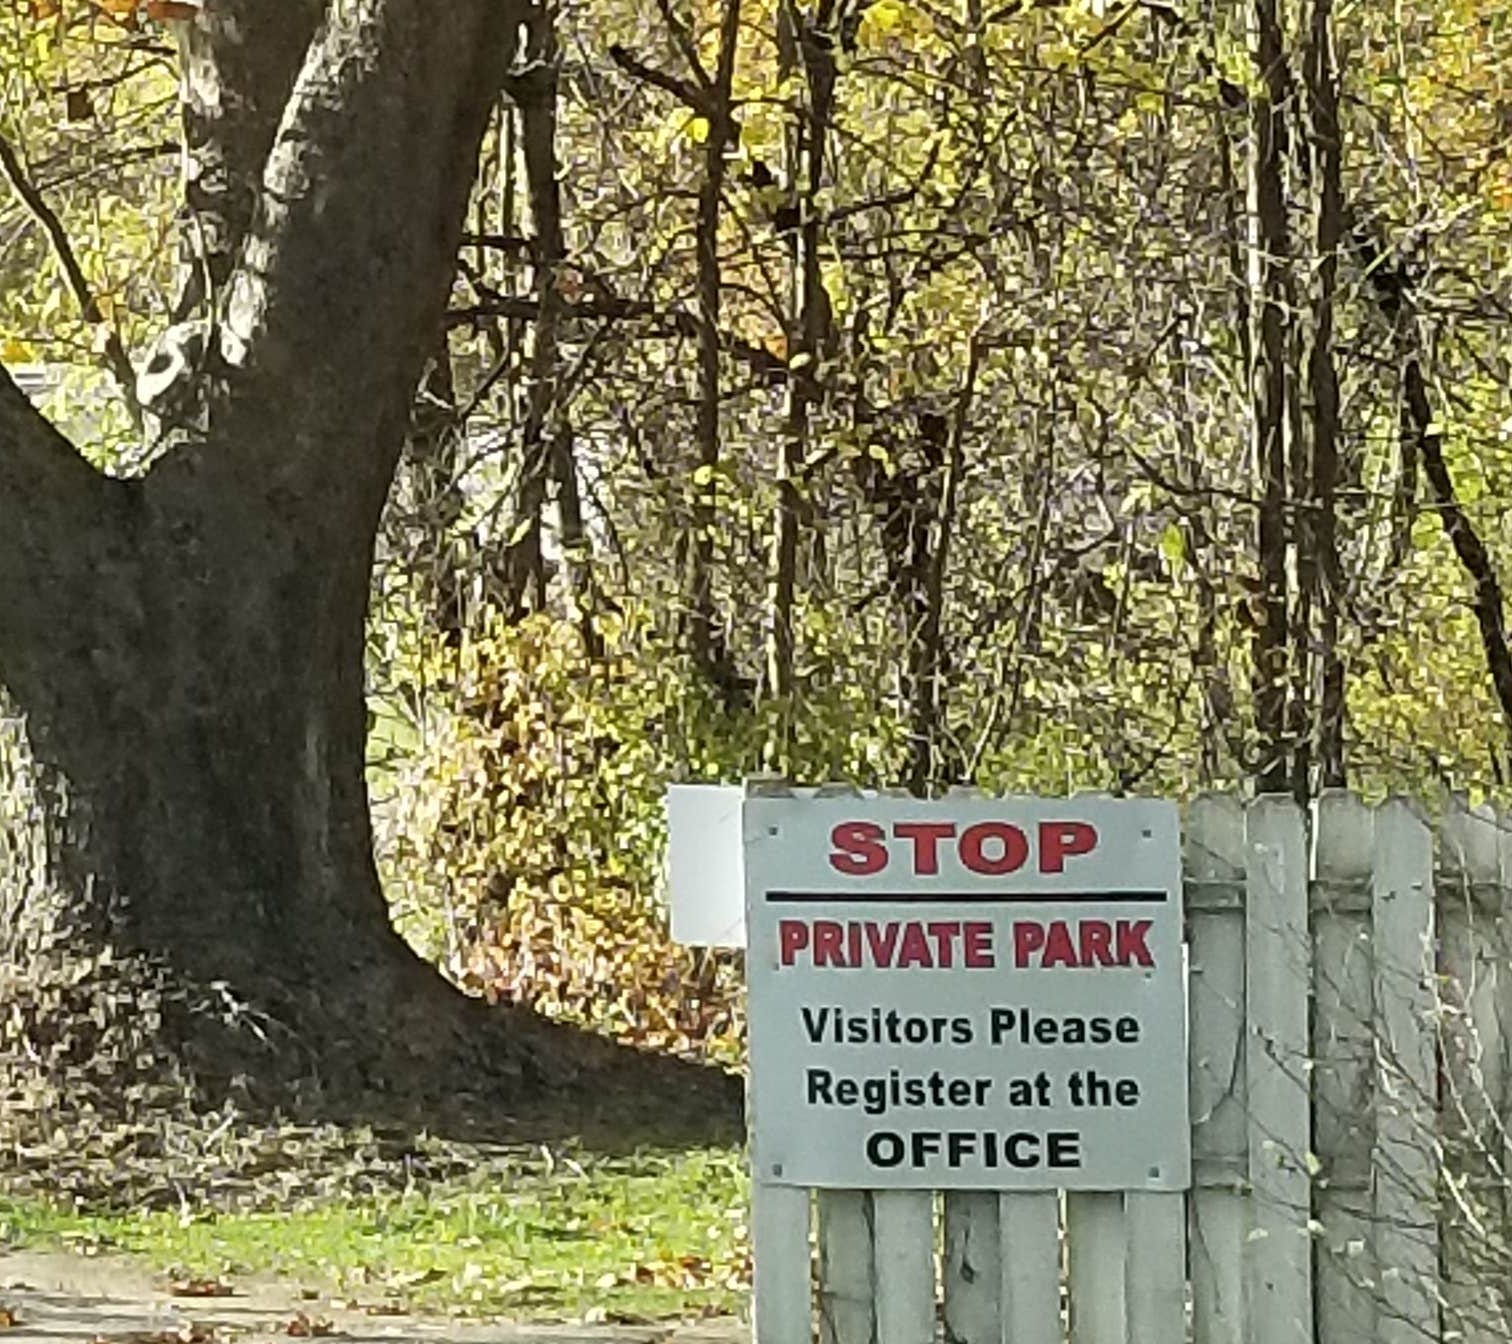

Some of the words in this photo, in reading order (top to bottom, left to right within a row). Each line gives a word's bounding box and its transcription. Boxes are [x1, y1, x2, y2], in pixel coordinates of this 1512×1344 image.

[829, 822, 1098, 875] STOP
[779, 920, 995, 968] PRIVATE
[1014, 920, 1155, 968] PARK
[801, 1007, 974, 1044] Visitors
[990, 1008, 1140, 1044] Please
[807, 1069, 991, 1115] Register
[1009, 1071, 1051, 1106] at
[1067, 1070, 1140, 1106] the
[865, 1131, 1081, 1168] OFFICE
